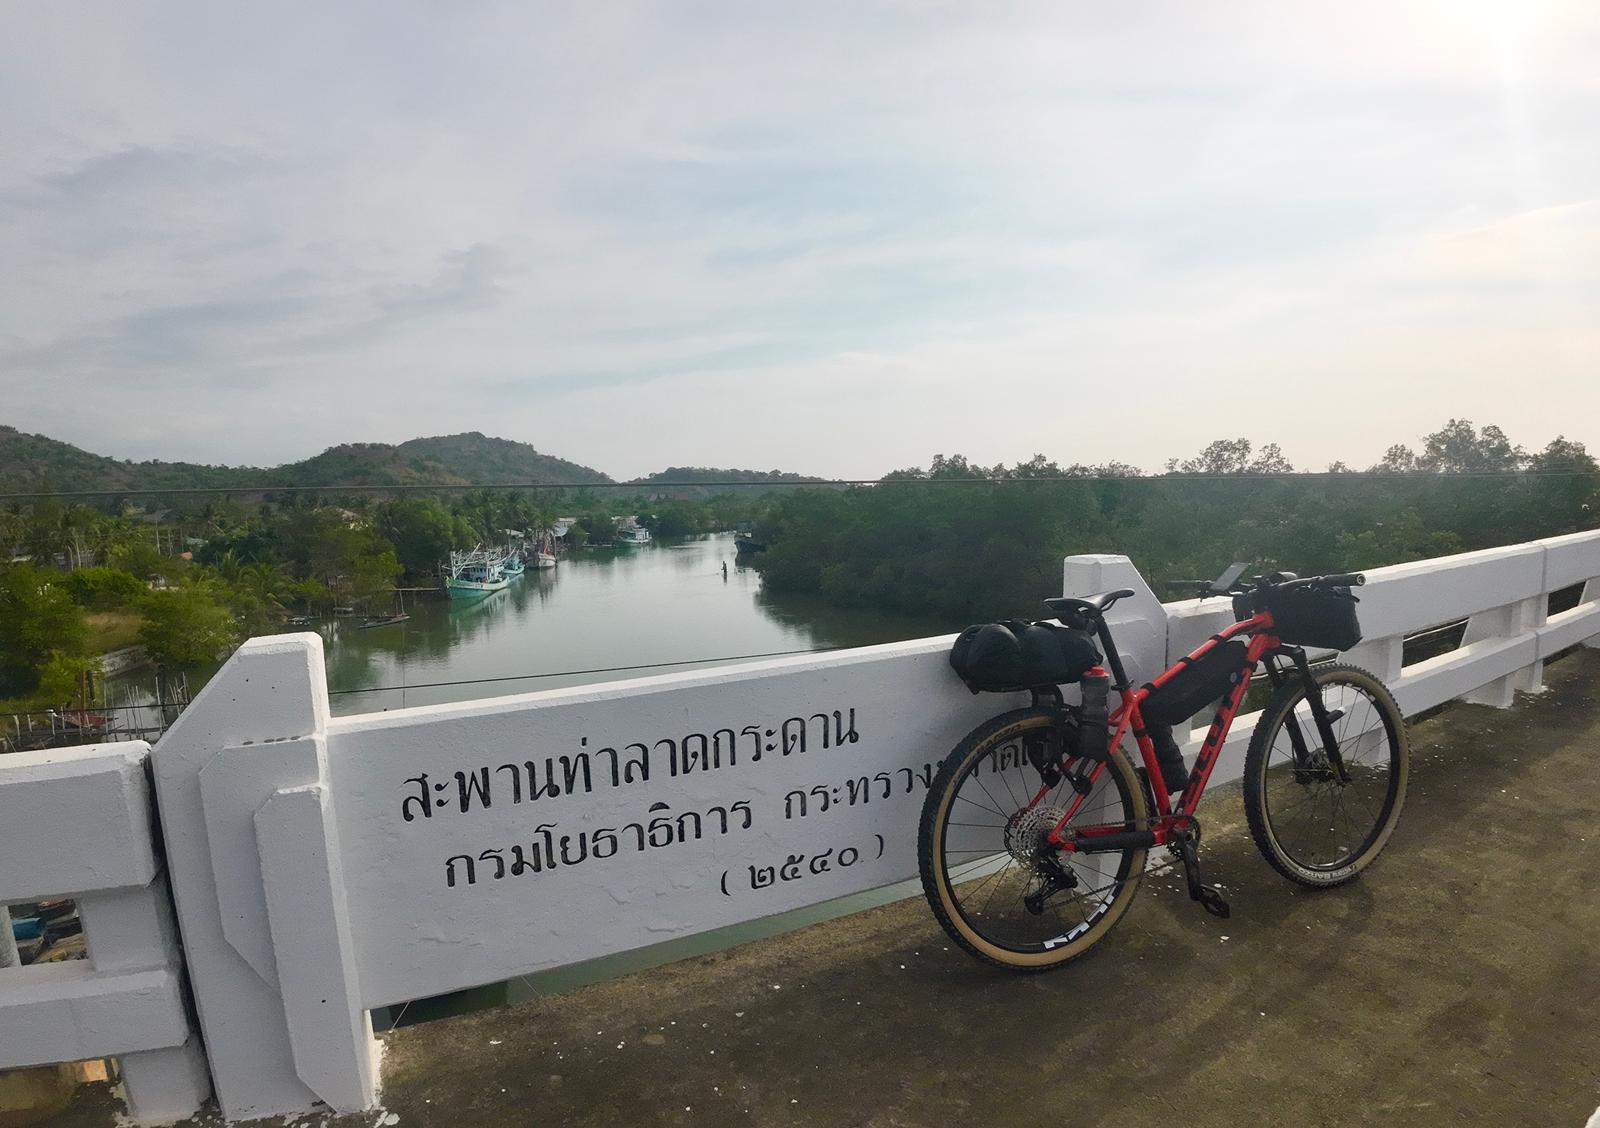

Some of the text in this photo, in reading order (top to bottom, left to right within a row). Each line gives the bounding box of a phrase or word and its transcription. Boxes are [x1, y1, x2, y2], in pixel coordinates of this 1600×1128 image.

[402, 707, 860, 822] สะพานท่าลาดกระดาน
[445, 799, 752, 888] กรมโยธาธิการ
